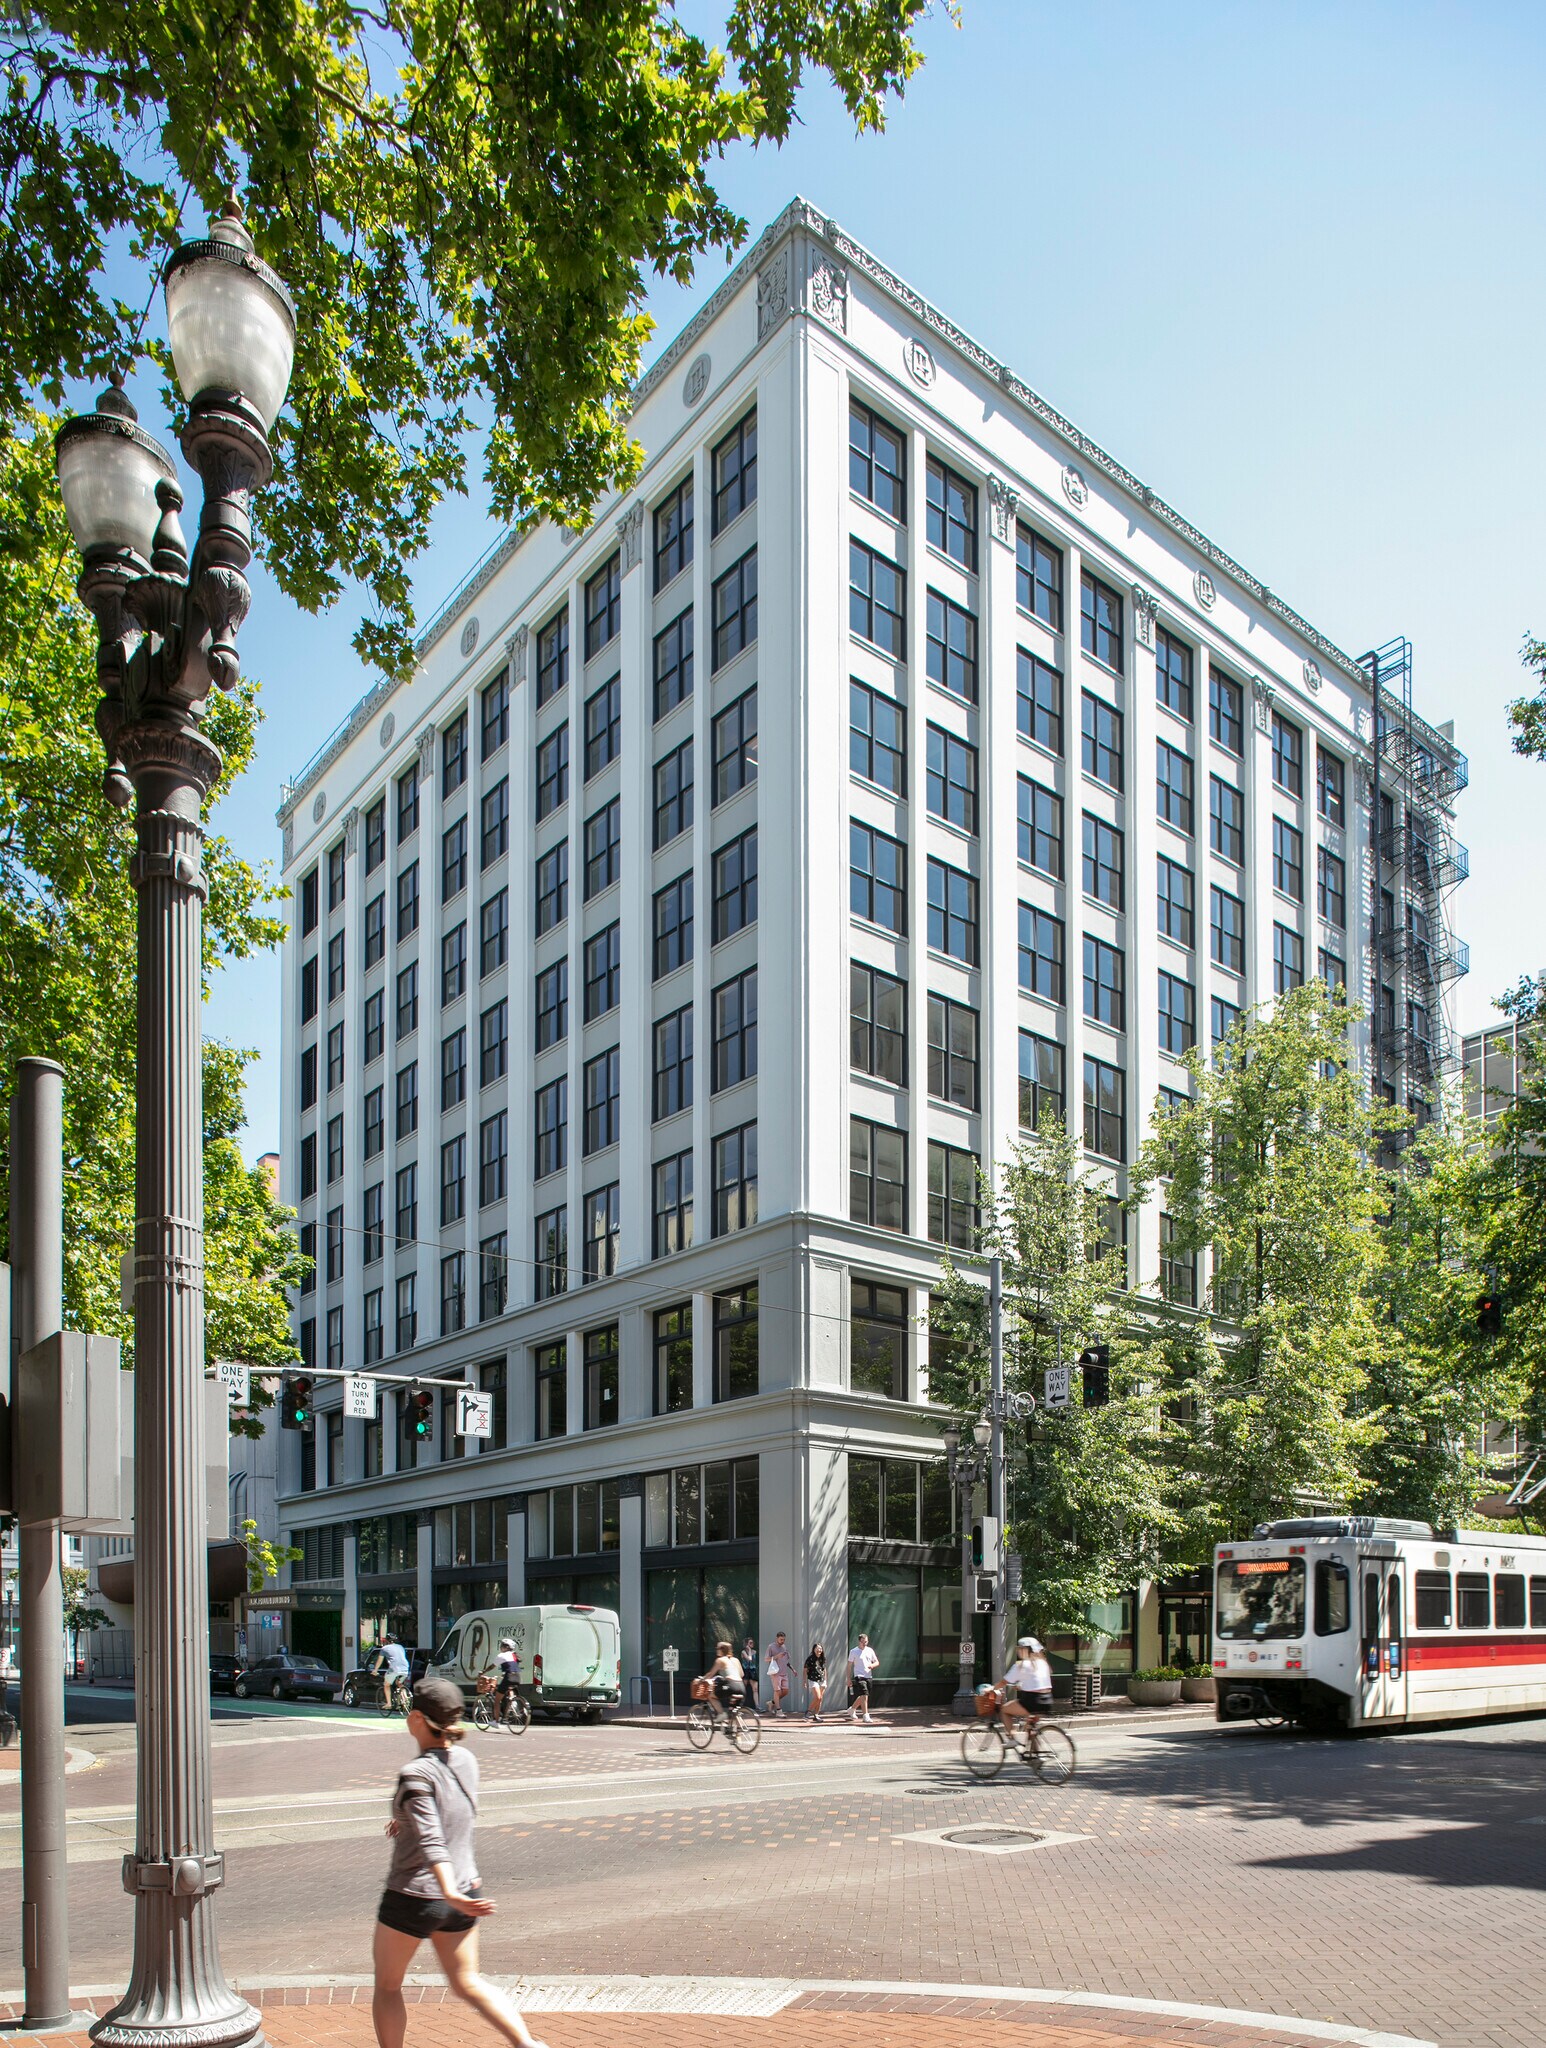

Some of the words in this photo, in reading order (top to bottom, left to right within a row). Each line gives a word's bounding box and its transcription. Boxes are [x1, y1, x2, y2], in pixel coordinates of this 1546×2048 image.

[222, 1366, 243, 1377] ONE
[1049, 1371, 1065, 1381] ONE
[353, 1381, 367, 1390] NO
[1049, 1381, 1066, 1392] WAY
[1250, 1548, 1271, 1557] 102
